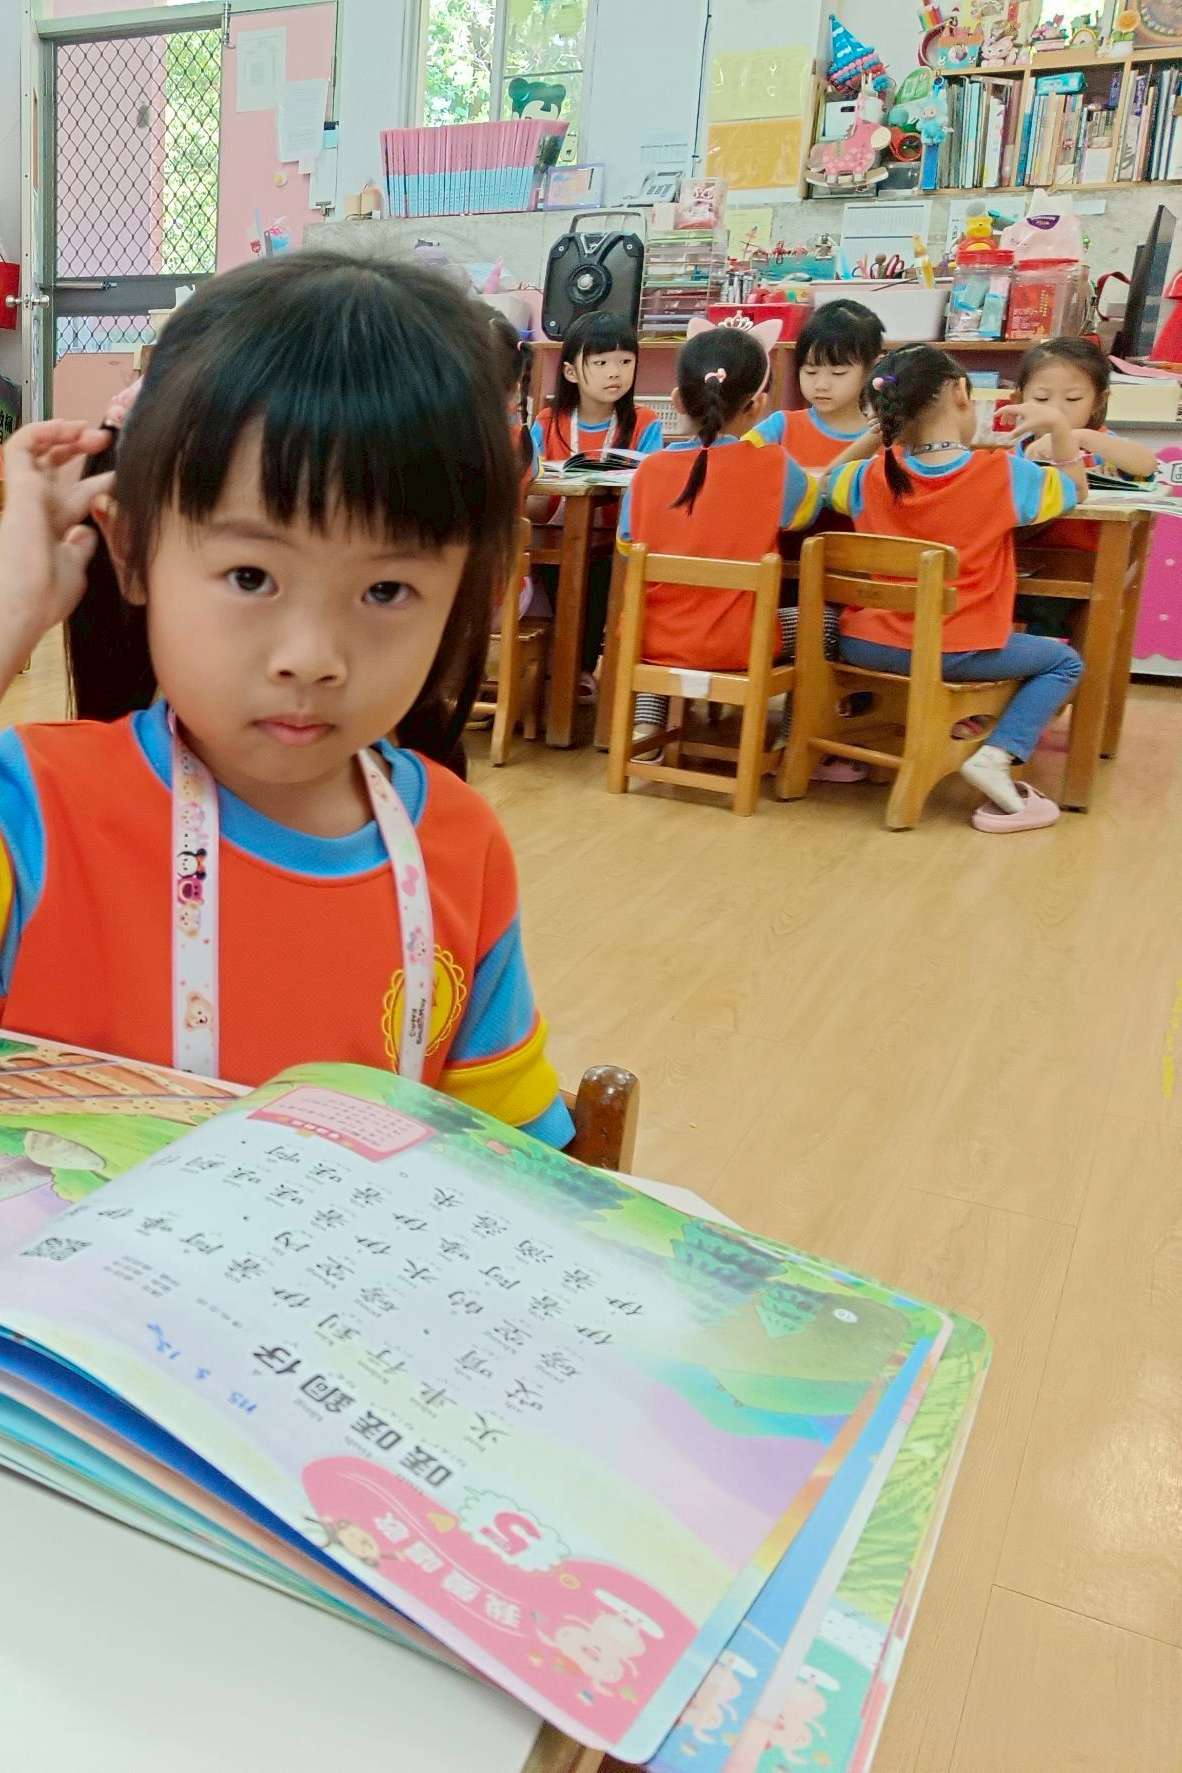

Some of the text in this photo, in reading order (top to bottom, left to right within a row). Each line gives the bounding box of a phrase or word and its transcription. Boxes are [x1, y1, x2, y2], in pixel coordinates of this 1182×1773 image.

[372, 1511, 521, 1629] 我愛唱歌
[480, 1511, 542, 1557] 5
